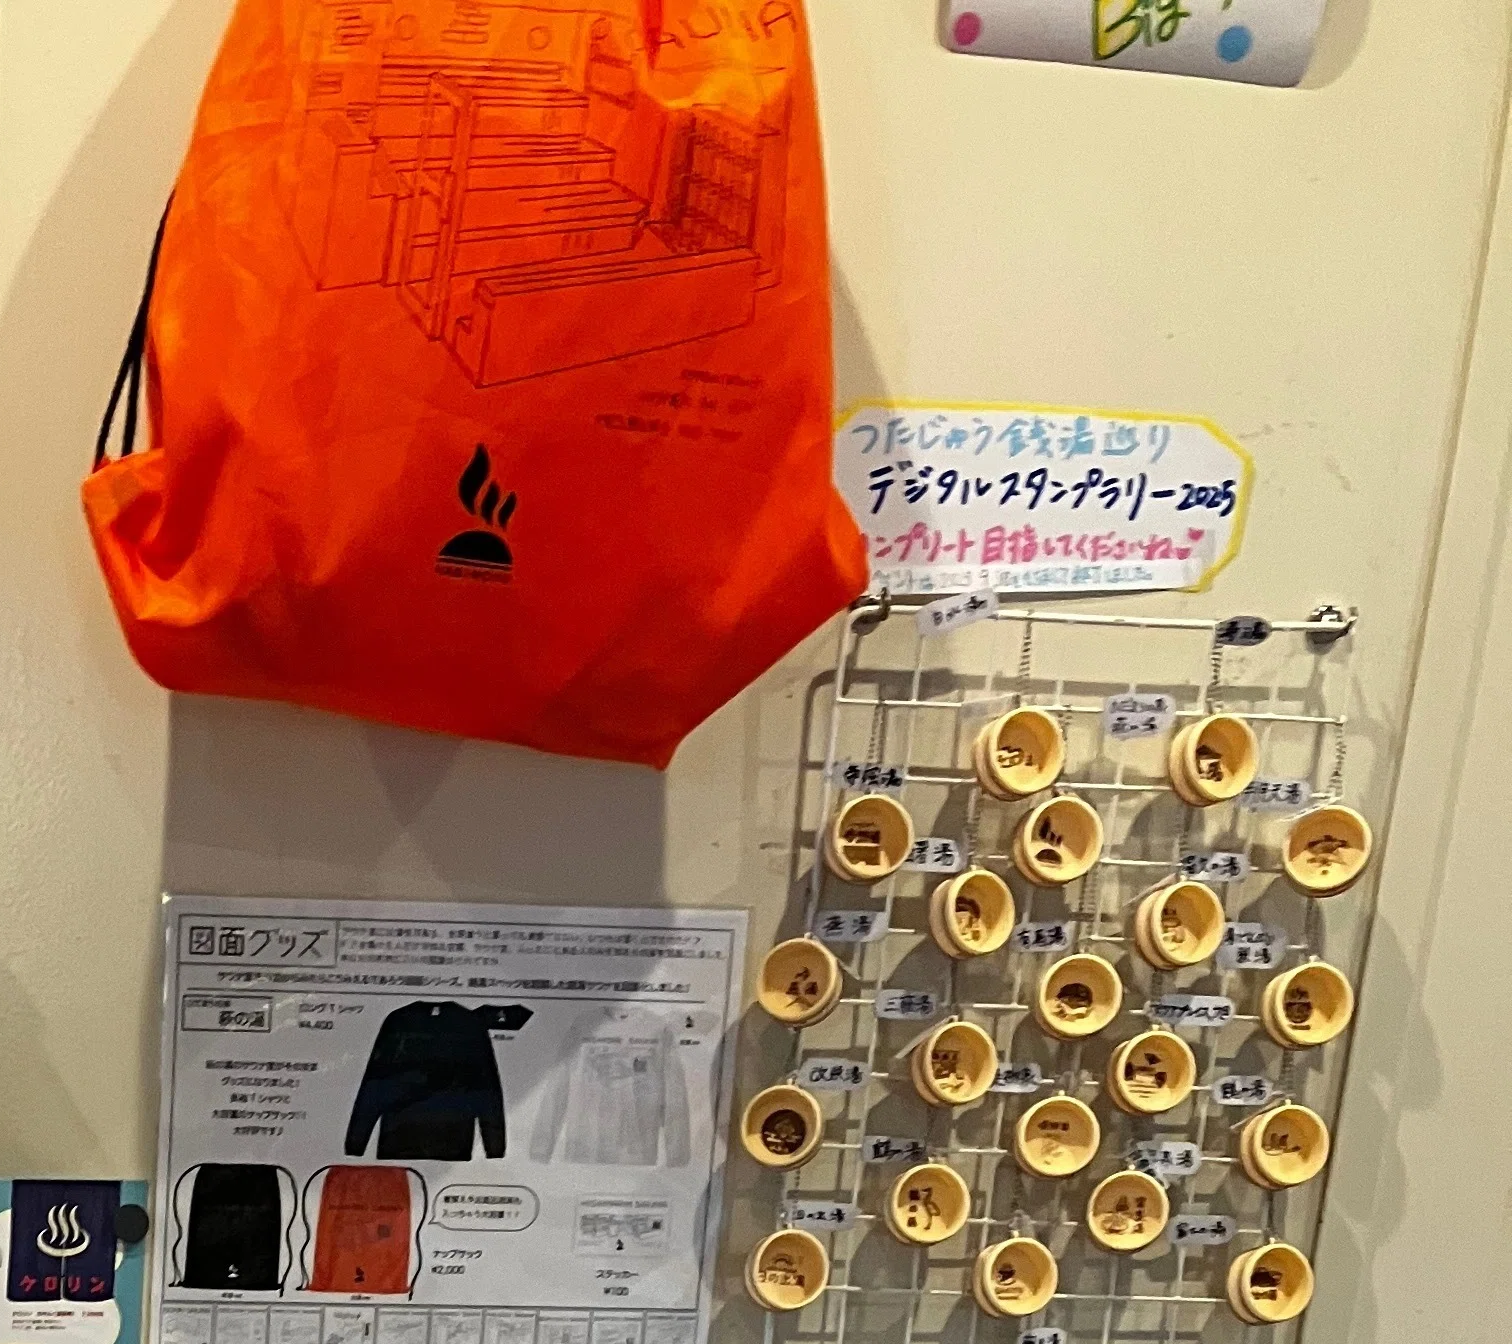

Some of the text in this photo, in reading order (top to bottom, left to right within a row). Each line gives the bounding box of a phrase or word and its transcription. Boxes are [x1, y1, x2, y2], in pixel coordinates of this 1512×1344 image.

[864, 521, 1192, 565] ンプリート目指してくださいね
[188, 926, 333, 960] 図面グッズ
[18, 1273, 106, 1294] ケロリン
